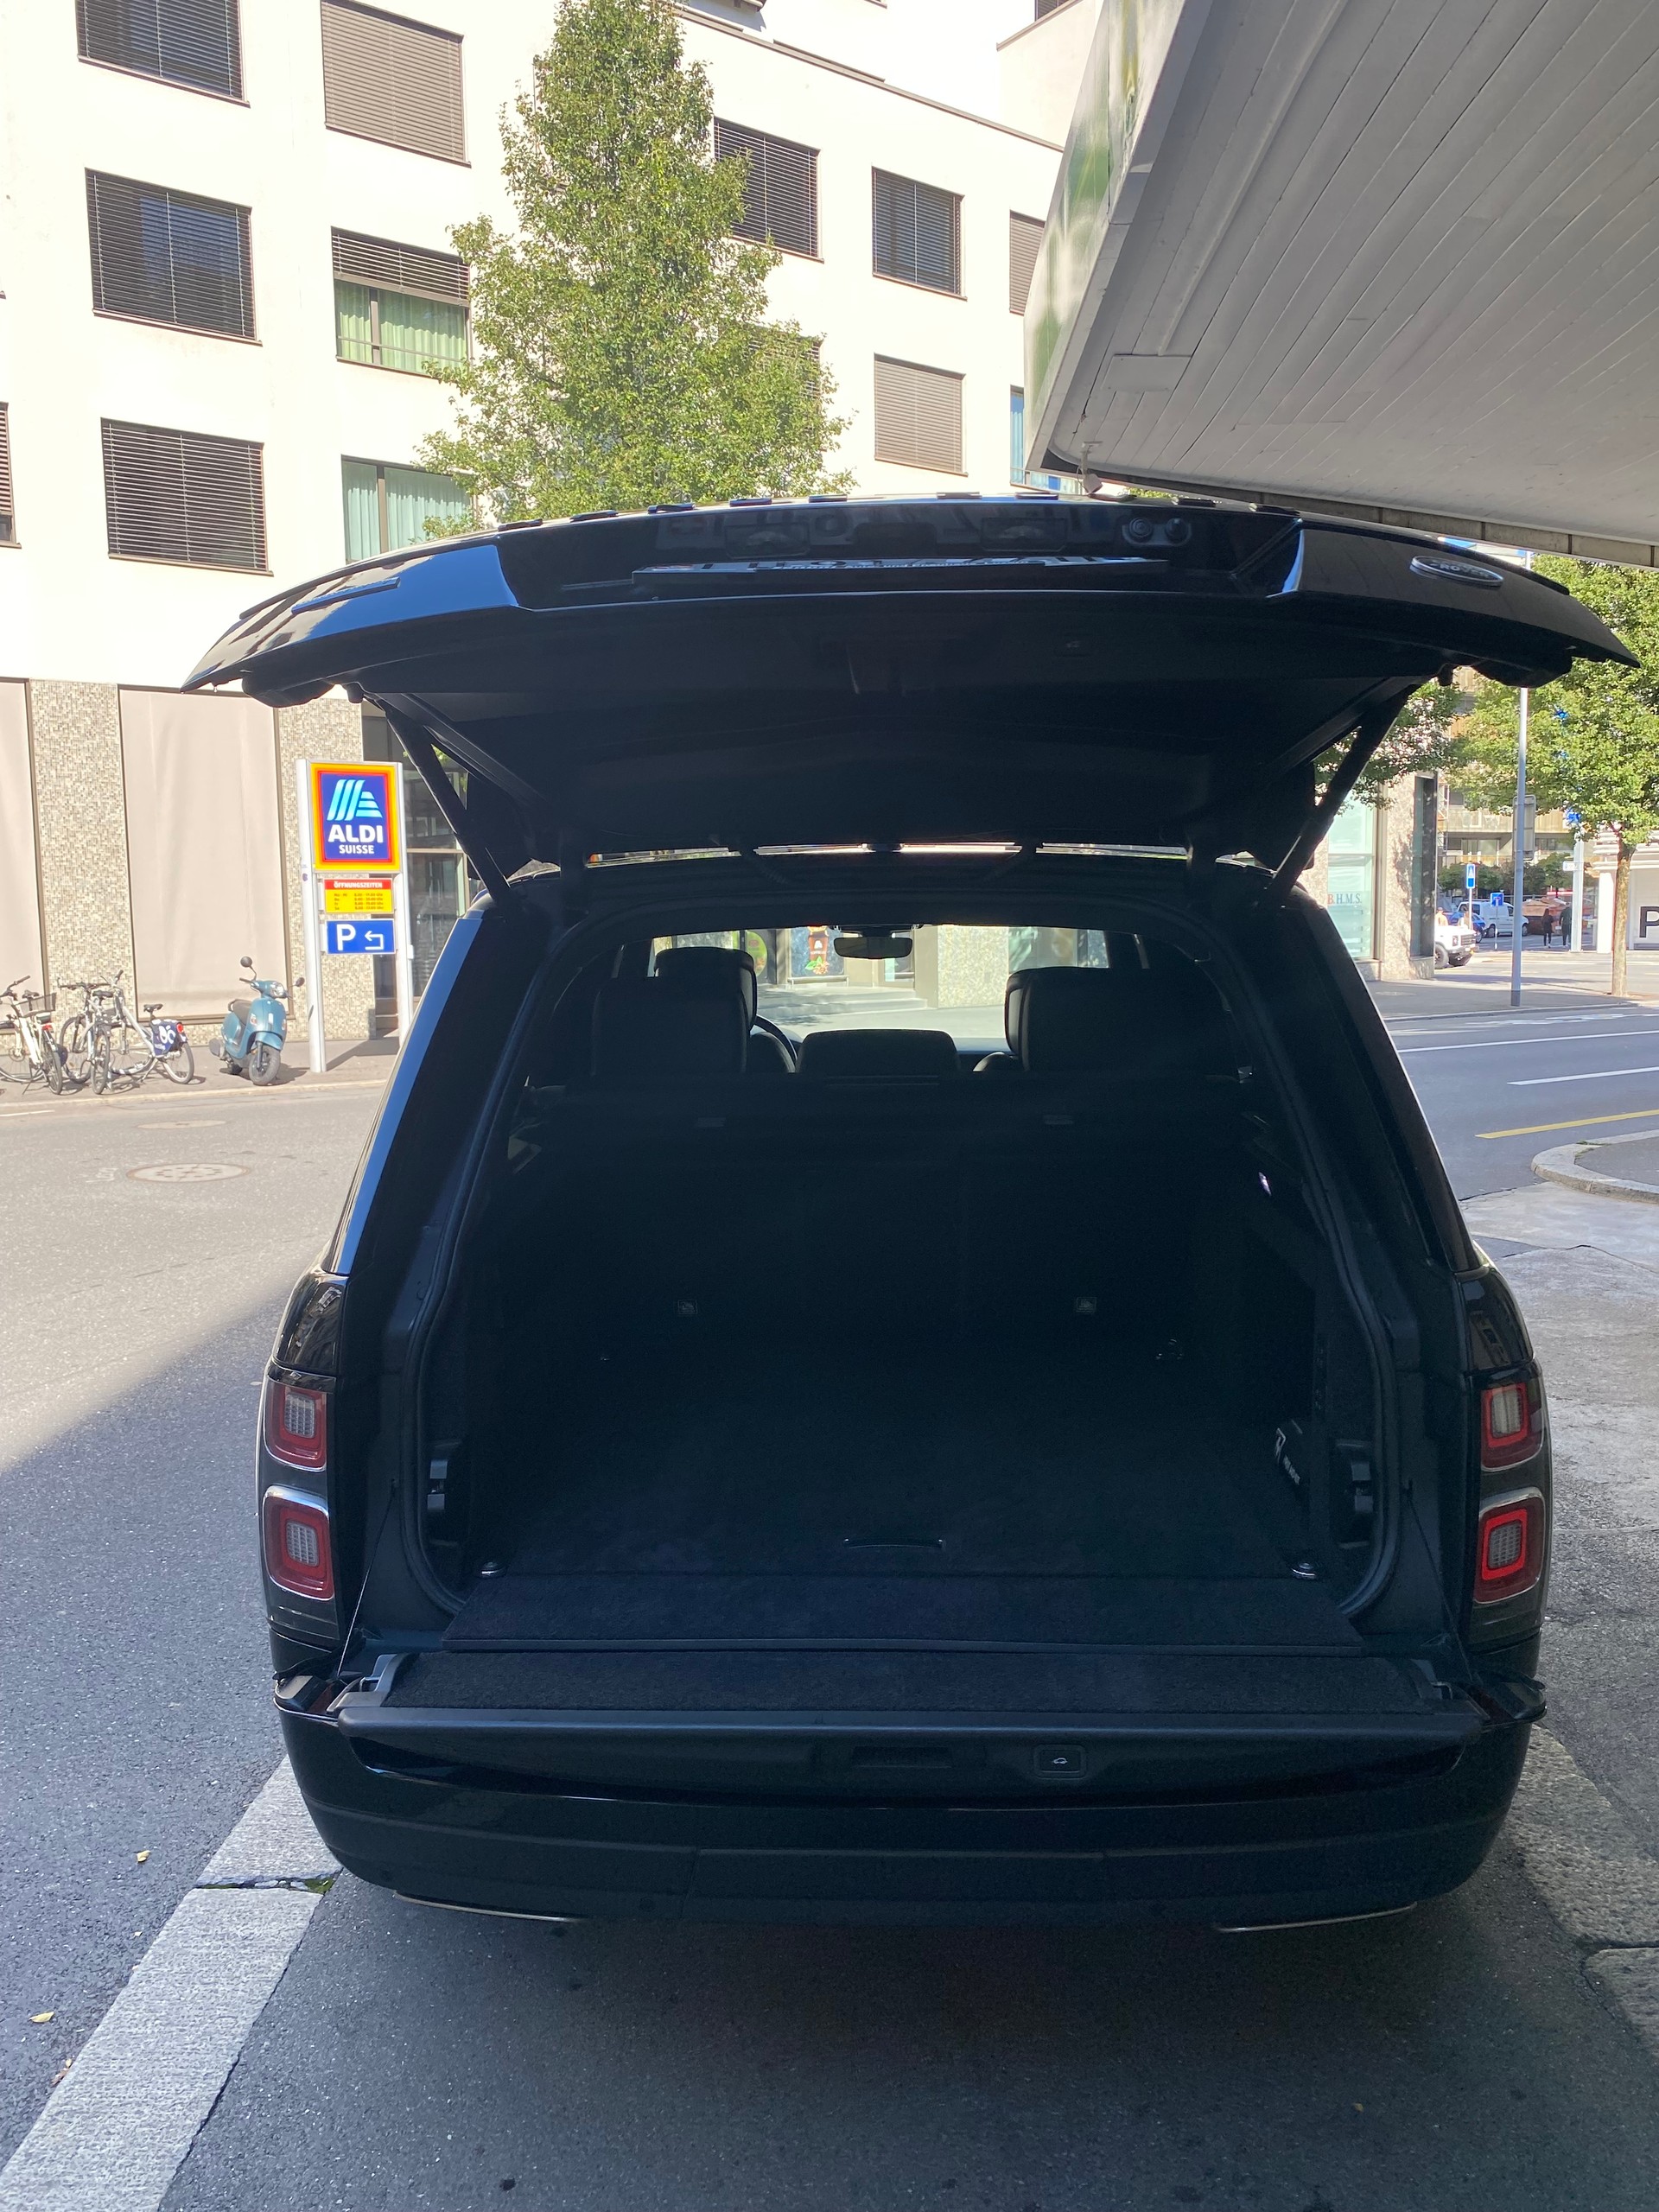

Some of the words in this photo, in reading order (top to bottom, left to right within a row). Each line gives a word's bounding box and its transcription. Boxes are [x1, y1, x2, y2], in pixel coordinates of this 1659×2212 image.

[327, 823, 384, 843] ALDI
[339, 844, 375, 855] SUISSE
[334, 880, 383, 888] ÖFFNUNGSZEITEN
[336, 924, 356, 951] P
